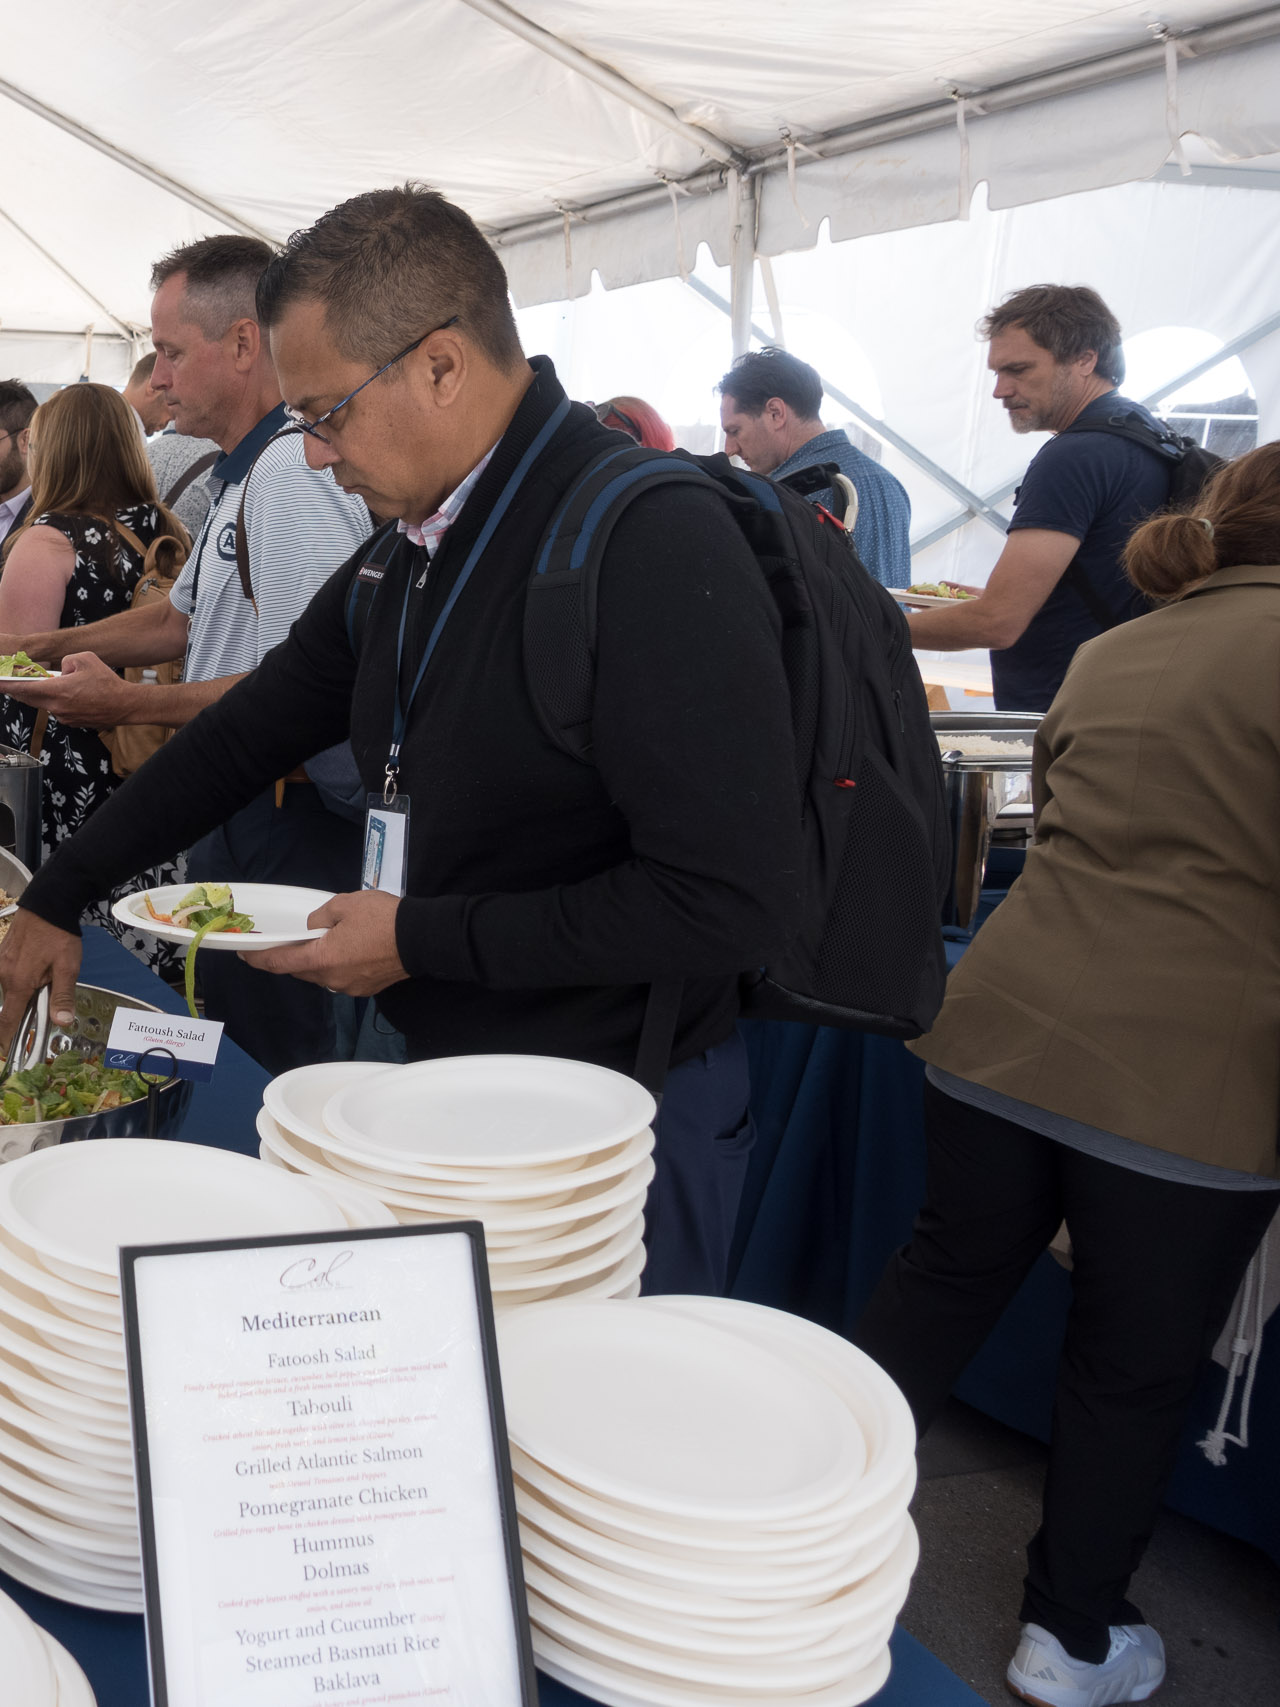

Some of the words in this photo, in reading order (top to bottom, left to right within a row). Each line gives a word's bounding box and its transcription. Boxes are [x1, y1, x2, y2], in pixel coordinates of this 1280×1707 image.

[128, 1021, 173, 1037] Fattoush
[176, 1029, 205, 1042] Salad
[144, 1036, 163, 1045] (Gluten
[164, 1038, 186, 1048] Allergy)
[242, 1310, 380, 1331] Mediterranean
[269, 1349, 329, 1368] Fatoosh
[335, 1344, 376, 1361] Salad
[287, 1396, 352, 1416] Tabouli
[235, 1456, 291, 1476] Grilled
[297, 1453, 357, 1470] Atlantic
[363, 1447, 423, 1462] Salmon
[239, 1496, 352, 1518] Pomegranate
[359, 1485, 427, 1504] Chicken
[293, 1536, 374, 1554] Hummus
[304, 1562, 369, 1581] Dolmas
[235, 1628, 290, 1646] Yogurt
[296, 1620, 325, 1638] and
[331, 1611, 415, 1633] Cucumber
[246, 1647, 322, 1672] Steamed
[329, 1643, 397, 1662] Basmati
[404, 1637, 439, 1653] Rice
[314, 1672, 380, 1693] Baklava
